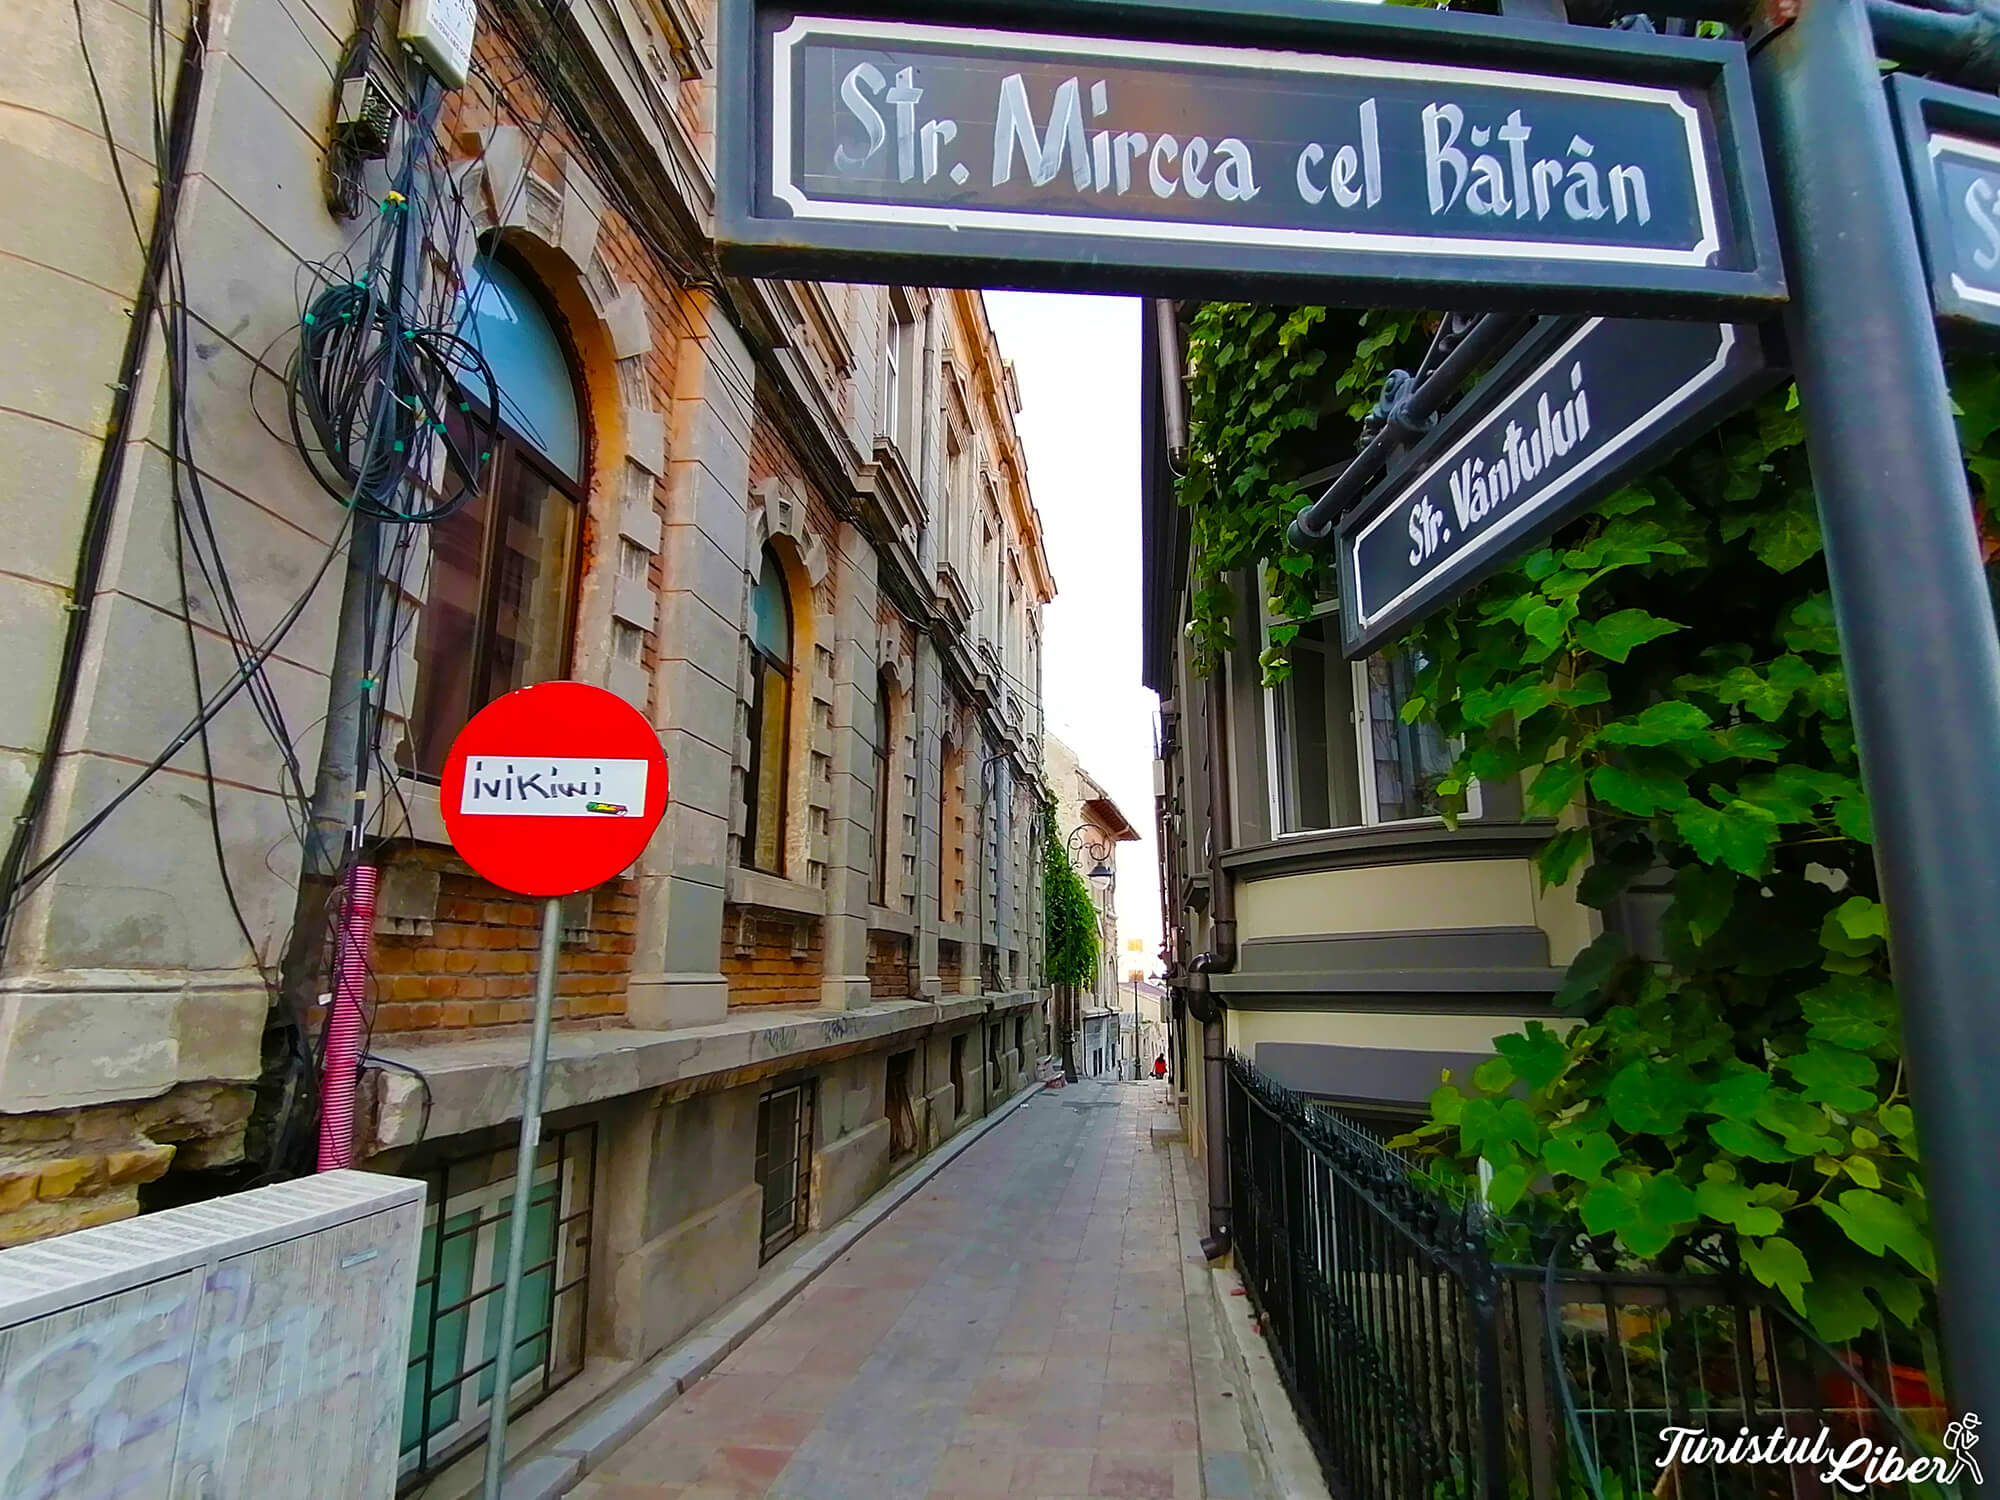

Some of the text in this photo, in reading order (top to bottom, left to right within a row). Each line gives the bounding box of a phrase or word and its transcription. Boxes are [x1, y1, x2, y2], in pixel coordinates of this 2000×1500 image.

[834, 62, 1651, 226] Str. Mircea cel Bătrân
[1965, 177, 2000, 271] S
[1408, 360, 1590, 566] Str. Vântului
